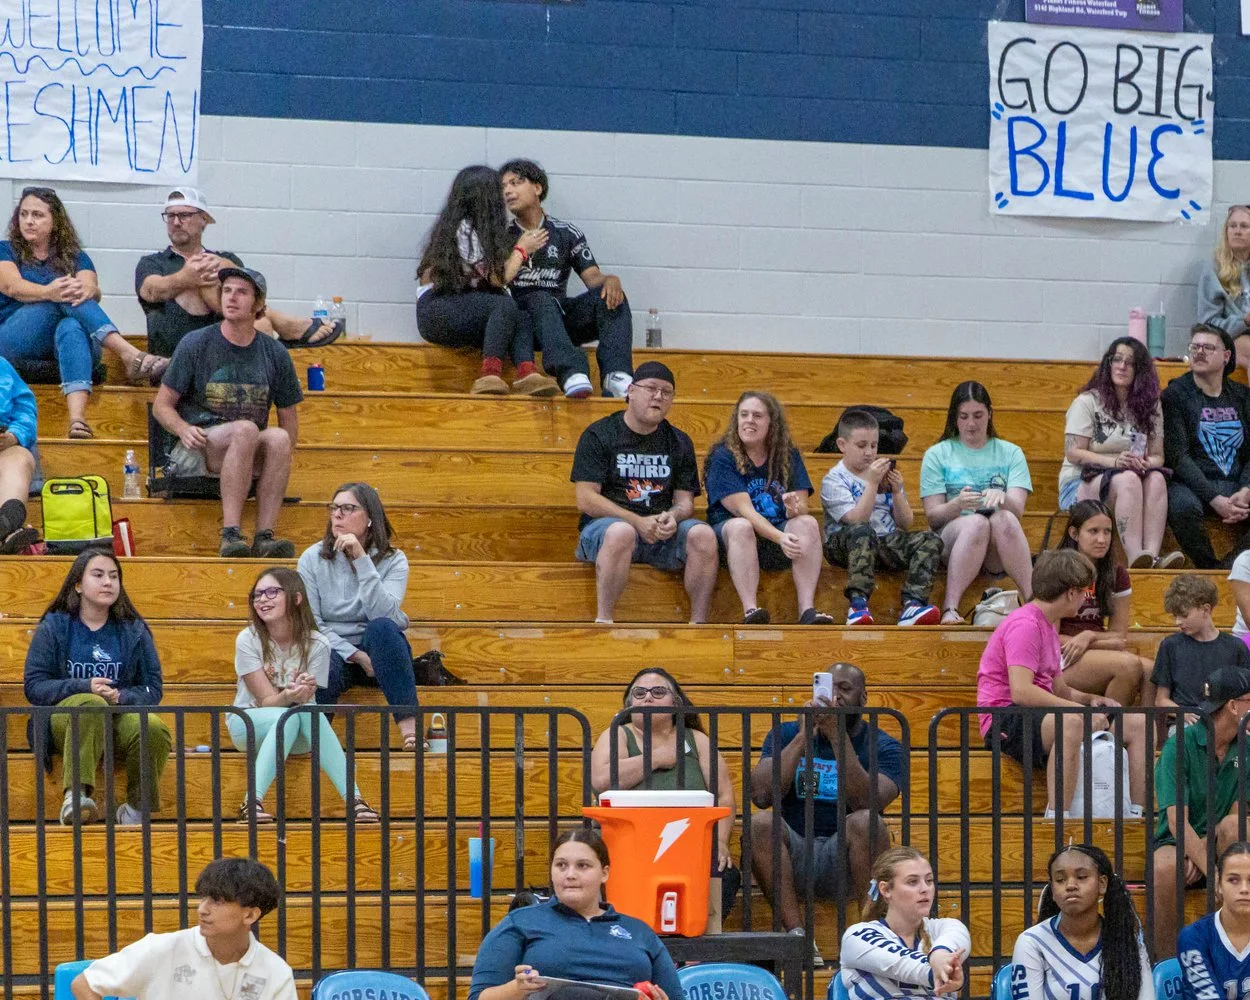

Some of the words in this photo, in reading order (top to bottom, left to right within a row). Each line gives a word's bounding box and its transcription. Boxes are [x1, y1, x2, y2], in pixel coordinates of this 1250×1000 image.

[998, 37, 1088, 115] GO
[1113, 43, 1204, 121] BIG
[0, 80, 197, 173] ESHMEN
[1007, 115, 1183, 202] BLUE
[616, 453, 669, 465] SAFETY
[617, 464, 671, 478] THIRD
